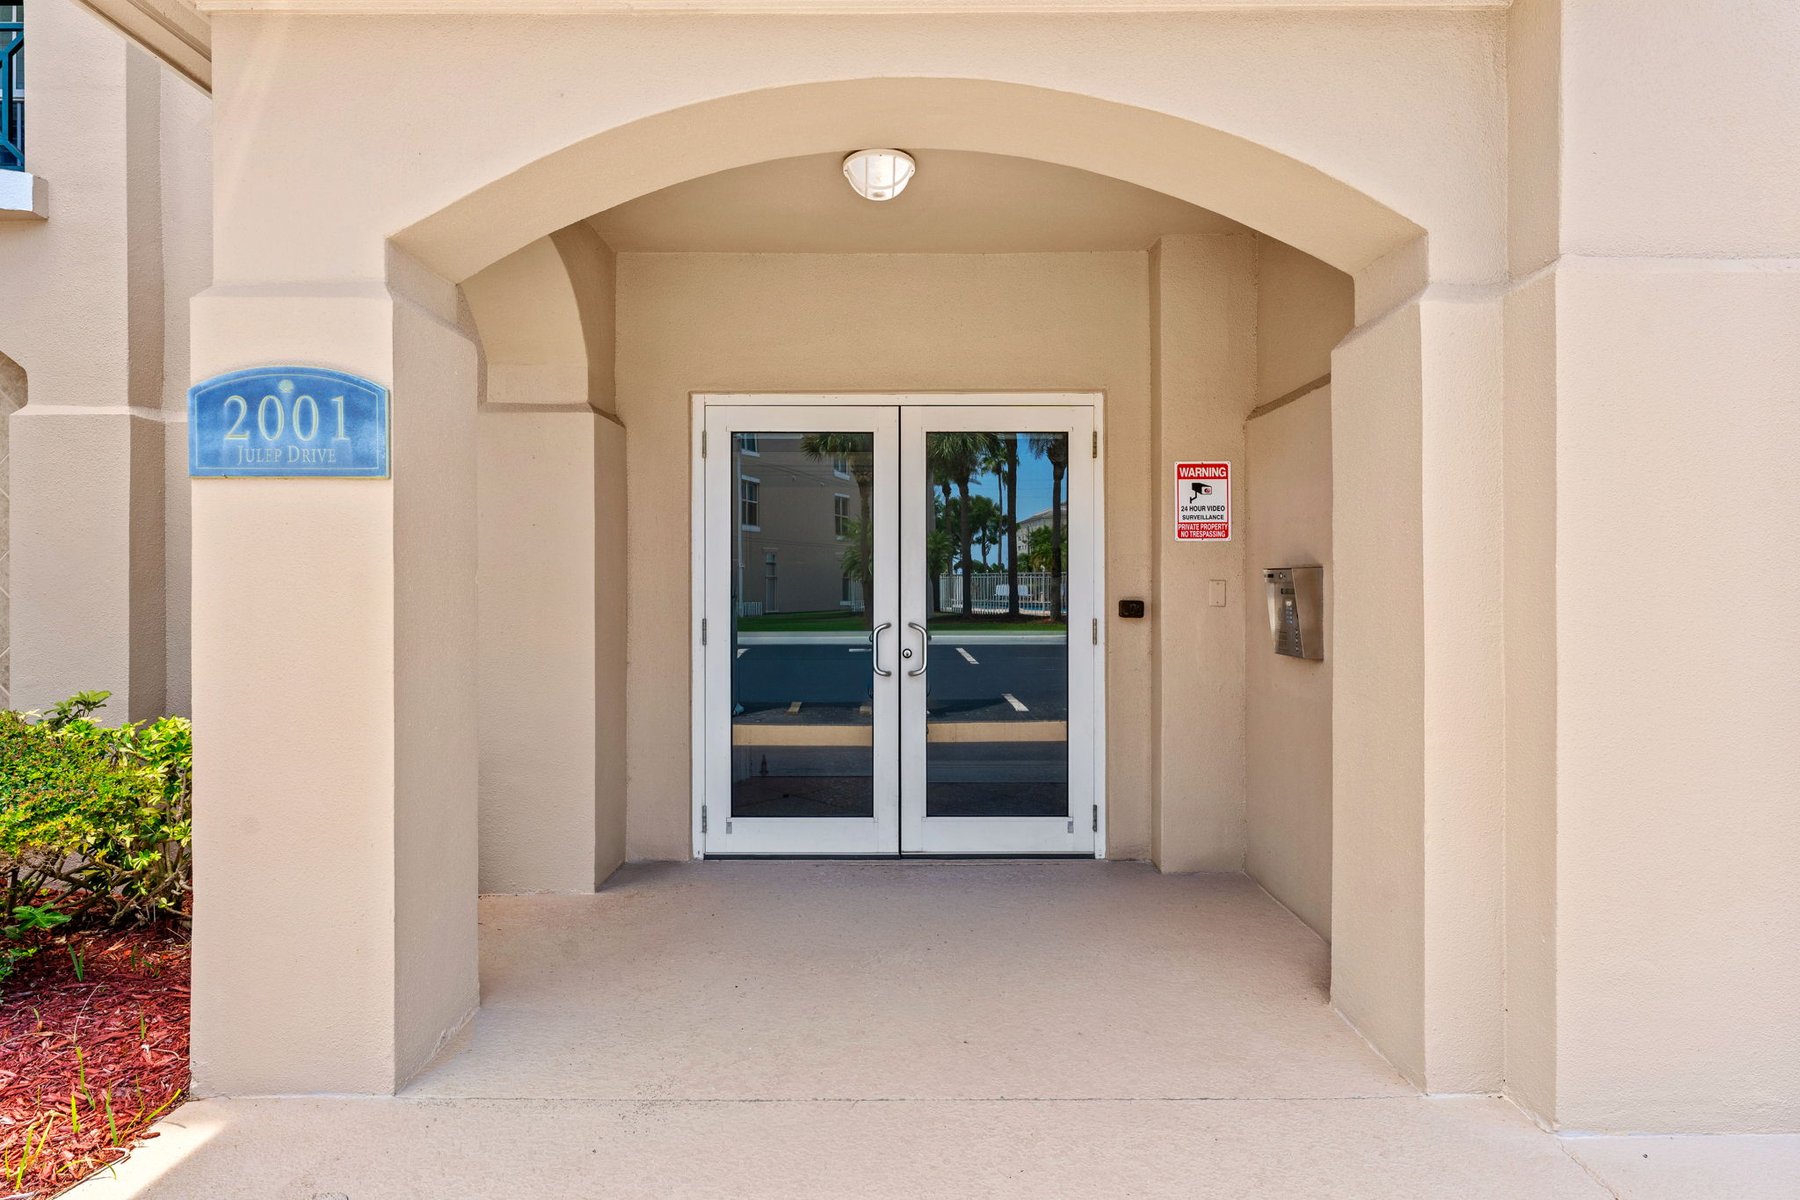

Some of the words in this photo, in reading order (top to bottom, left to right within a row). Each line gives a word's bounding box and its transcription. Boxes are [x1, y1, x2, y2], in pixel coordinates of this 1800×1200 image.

[224, 395, 350, 441] 2001
[288, 445, 337, 463] DRIVE
[1179, 467, 1227, 477] WARNING
